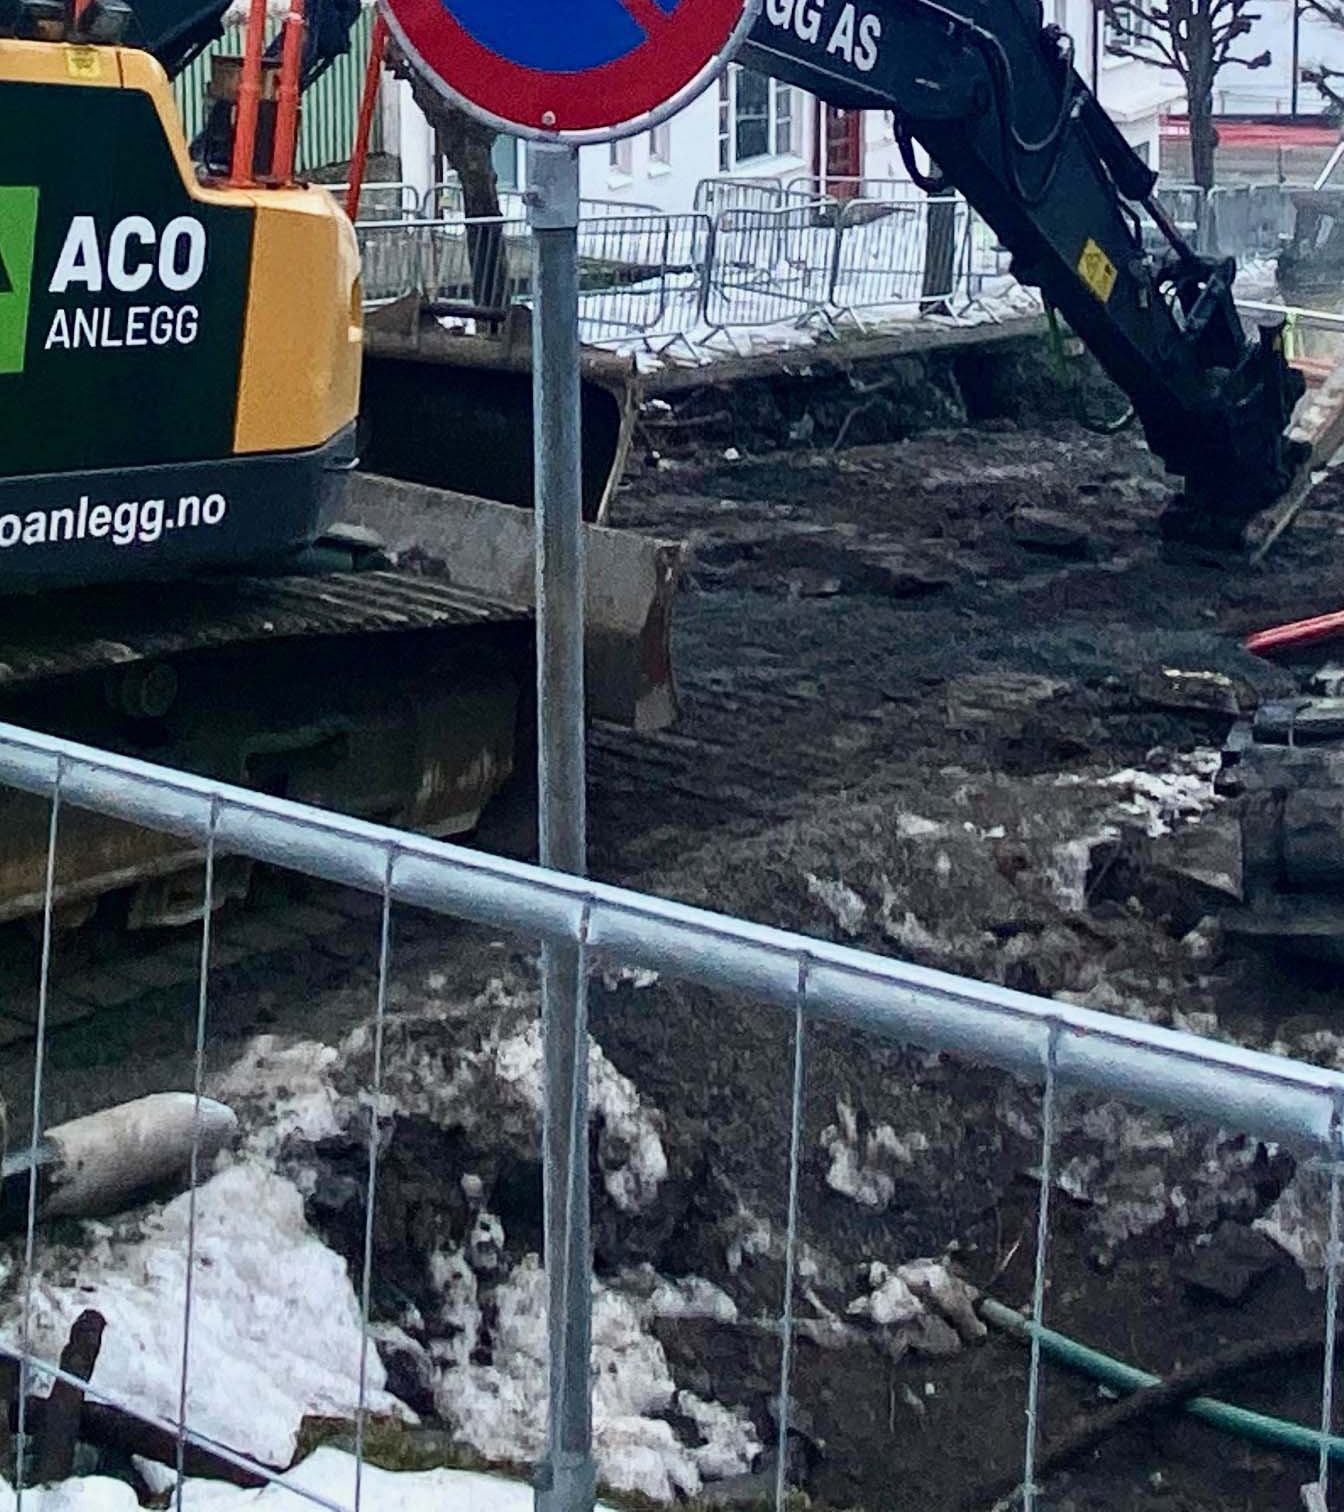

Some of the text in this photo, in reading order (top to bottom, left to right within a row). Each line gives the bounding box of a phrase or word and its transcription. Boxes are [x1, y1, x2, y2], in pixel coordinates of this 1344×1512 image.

[826, 1, 881, 71] AS
[47, 215, 207, 294] ACO
[44, 304, 199, 350] ANLEGG
